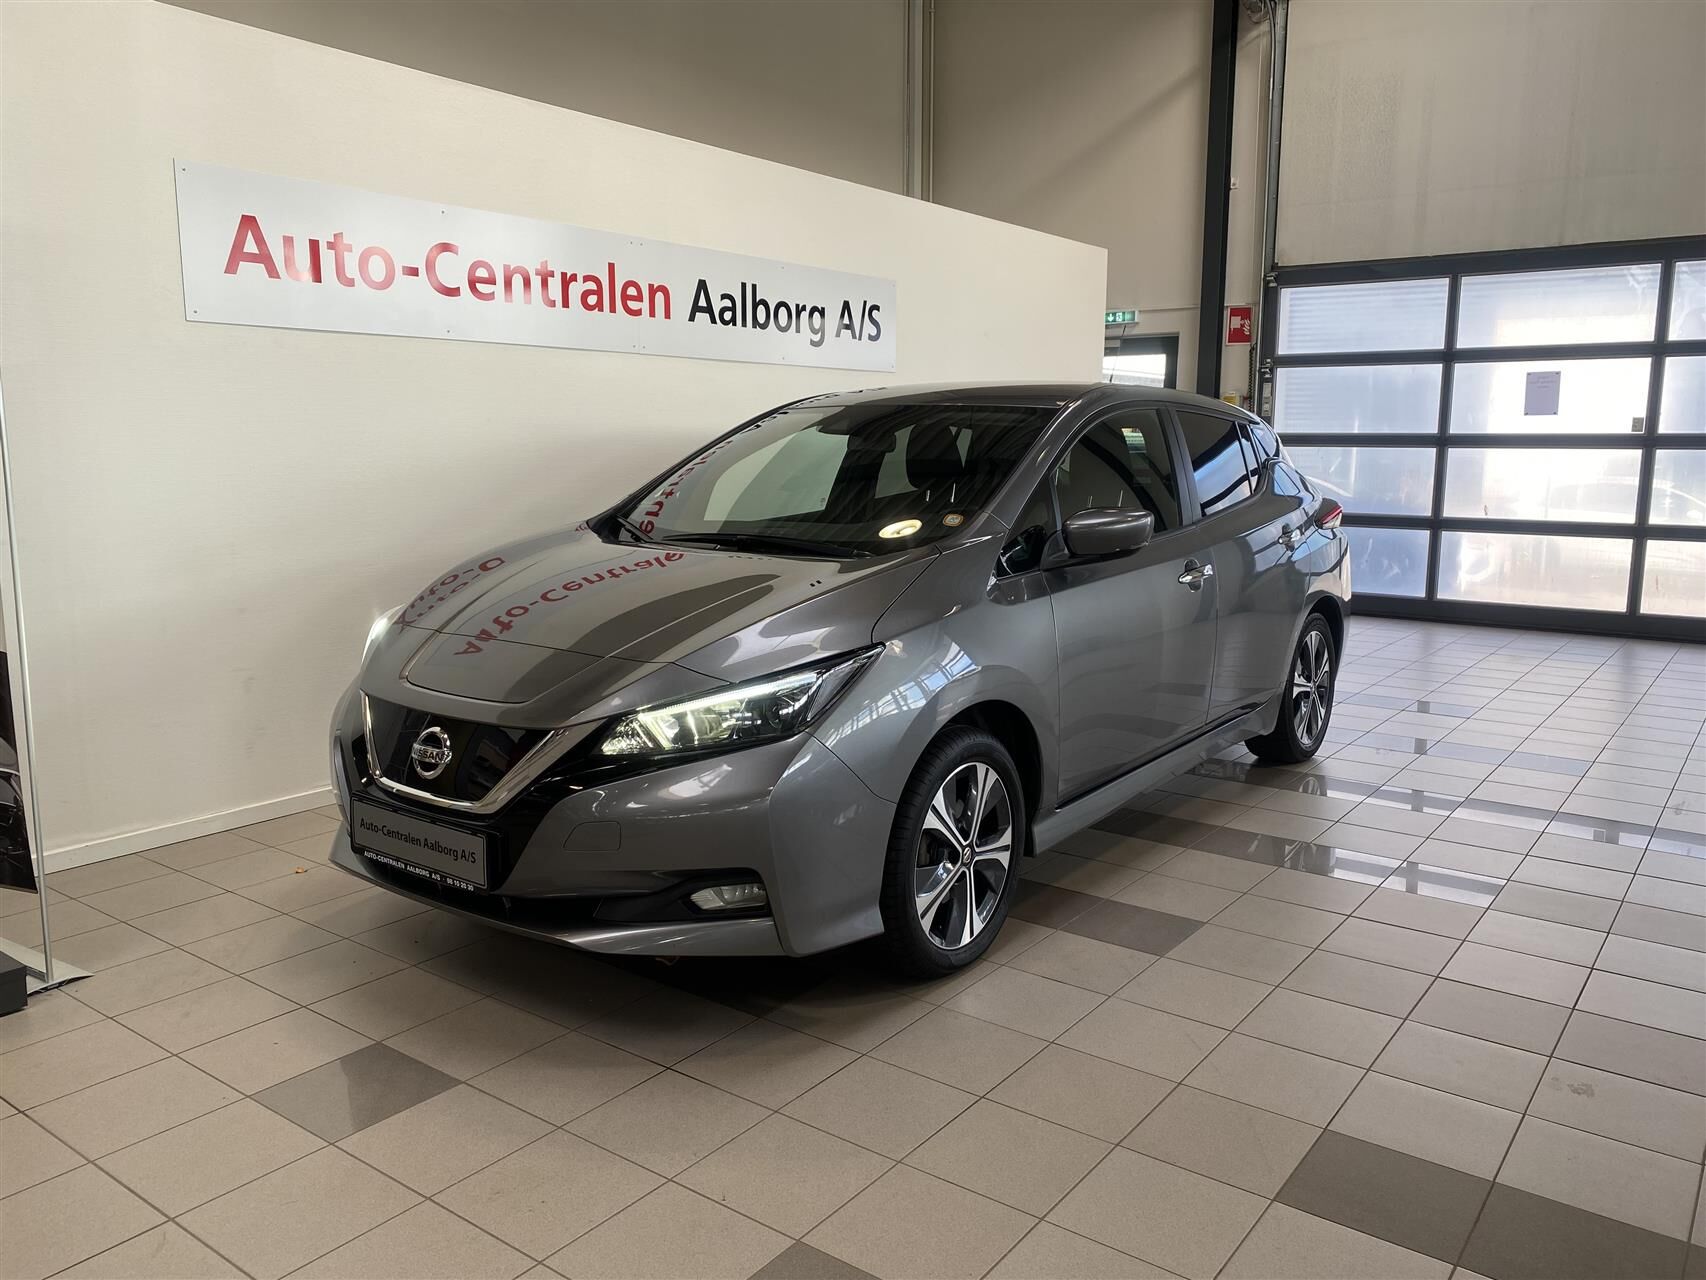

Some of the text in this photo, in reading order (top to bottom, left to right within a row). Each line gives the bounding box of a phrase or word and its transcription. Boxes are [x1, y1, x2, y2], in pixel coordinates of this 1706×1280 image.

[223, 213, 882, 347] Auto-Centralen Aalborg A/S
[360, 818, 476, 864] Auto-Centralen Aalborg A/S
[364, 850, 405, 869] AUTO-CENTRALEN
[406, 865, 430, 878] AALBORG
[431, 873, 441, 881] A/S
